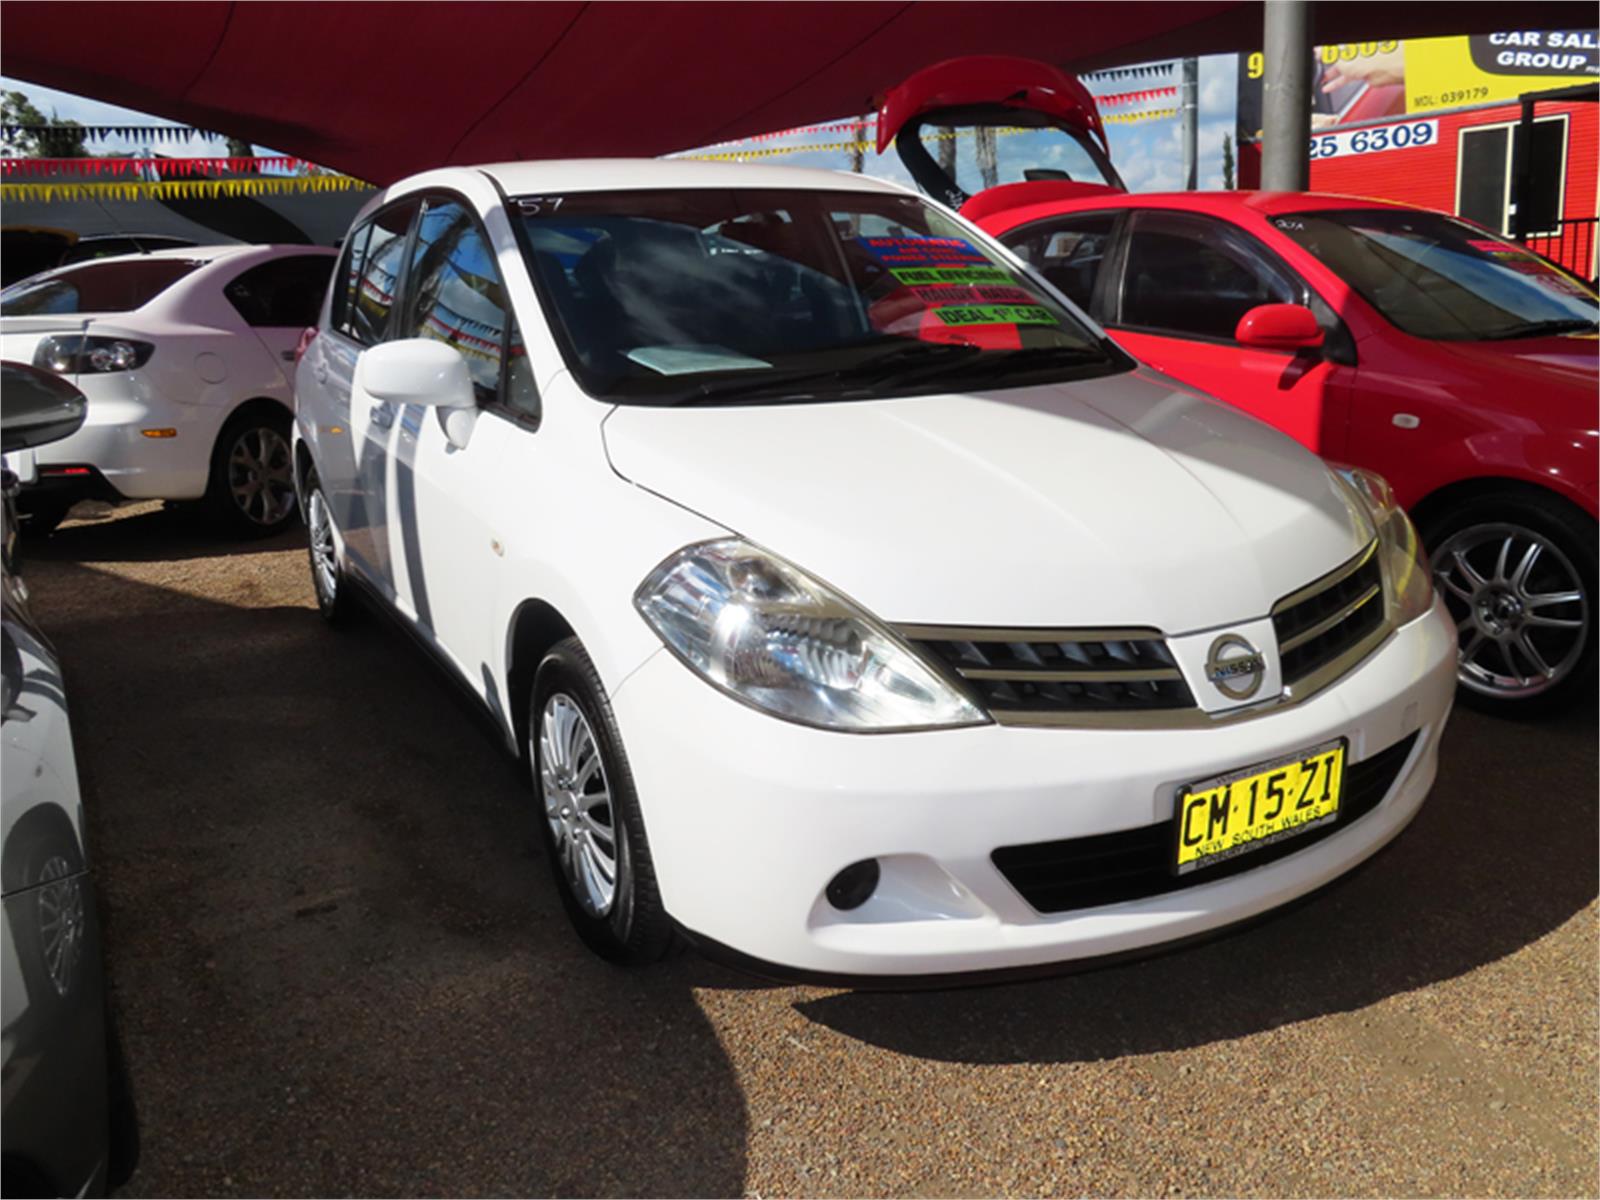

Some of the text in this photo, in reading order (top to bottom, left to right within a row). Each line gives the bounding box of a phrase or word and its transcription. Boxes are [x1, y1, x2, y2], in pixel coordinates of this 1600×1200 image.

[1489, 31, 1599, 49] CAR SAL
[1497, 51, 1587, 70] GROUP
[1441, 86, 1489, 104] 039179
[1350, 122, 1432, 153] 6309
[898, 270, 934, 281] FUEL
[940, 309, 994, 323] IDEAL
[1015, 307, 1052, 321] CAR
[1213, 656, 1263, 678] NISSAN
[1196, 840, 1223, 857] NEW
[1233, 822, 1275, 845] SOUTH
[1281, 805, 1322, 829] WALES
